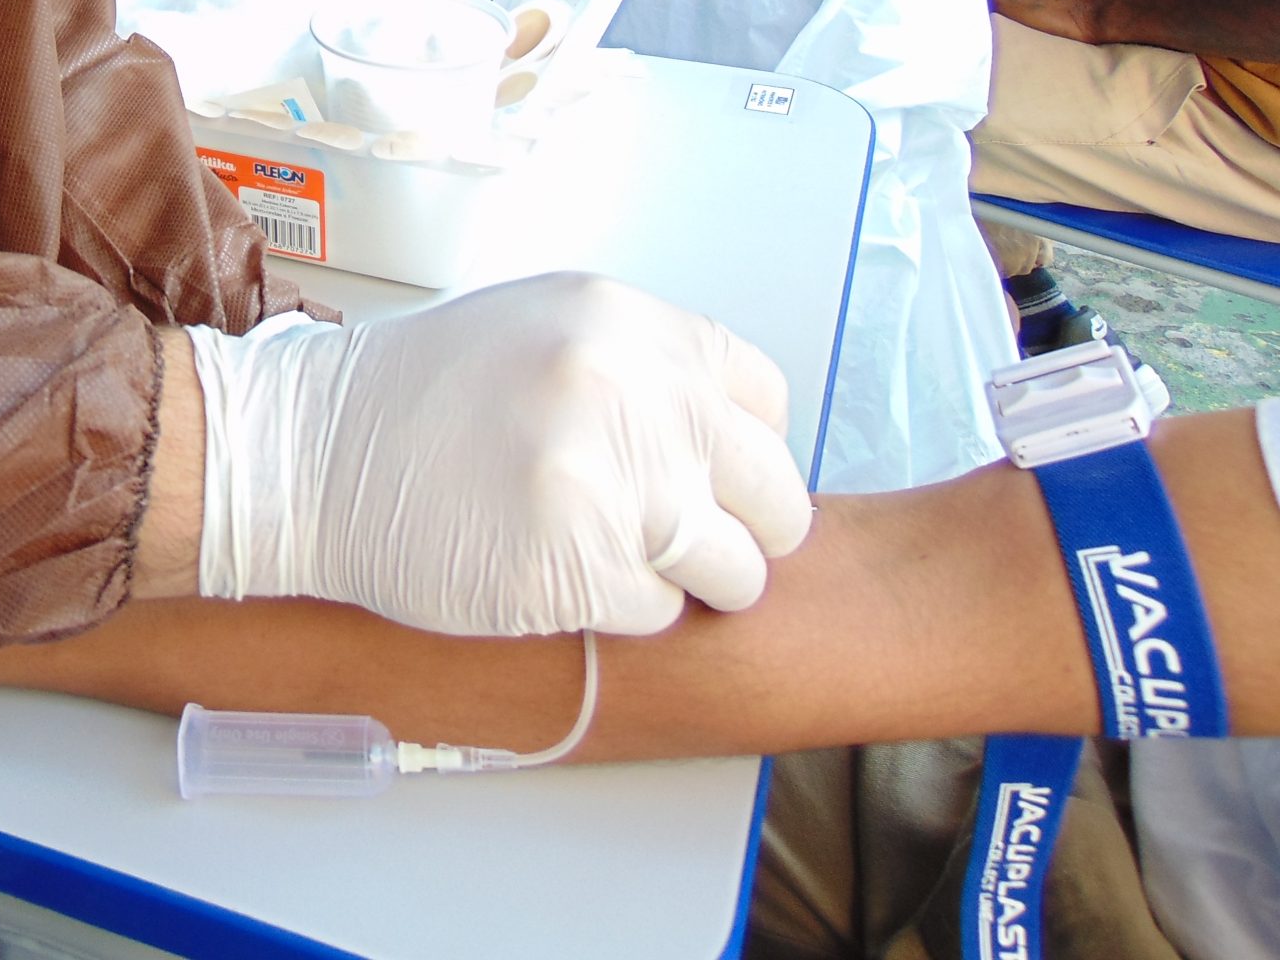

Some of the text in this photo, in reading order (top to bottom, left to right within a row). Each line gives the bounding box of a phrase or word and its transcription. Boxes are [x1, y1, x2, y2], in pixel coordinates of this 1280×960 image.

[254, 162, 306, 184] PLEION
[209, 726, 242, 742] Only
[245, 728, 270, 743] Use
